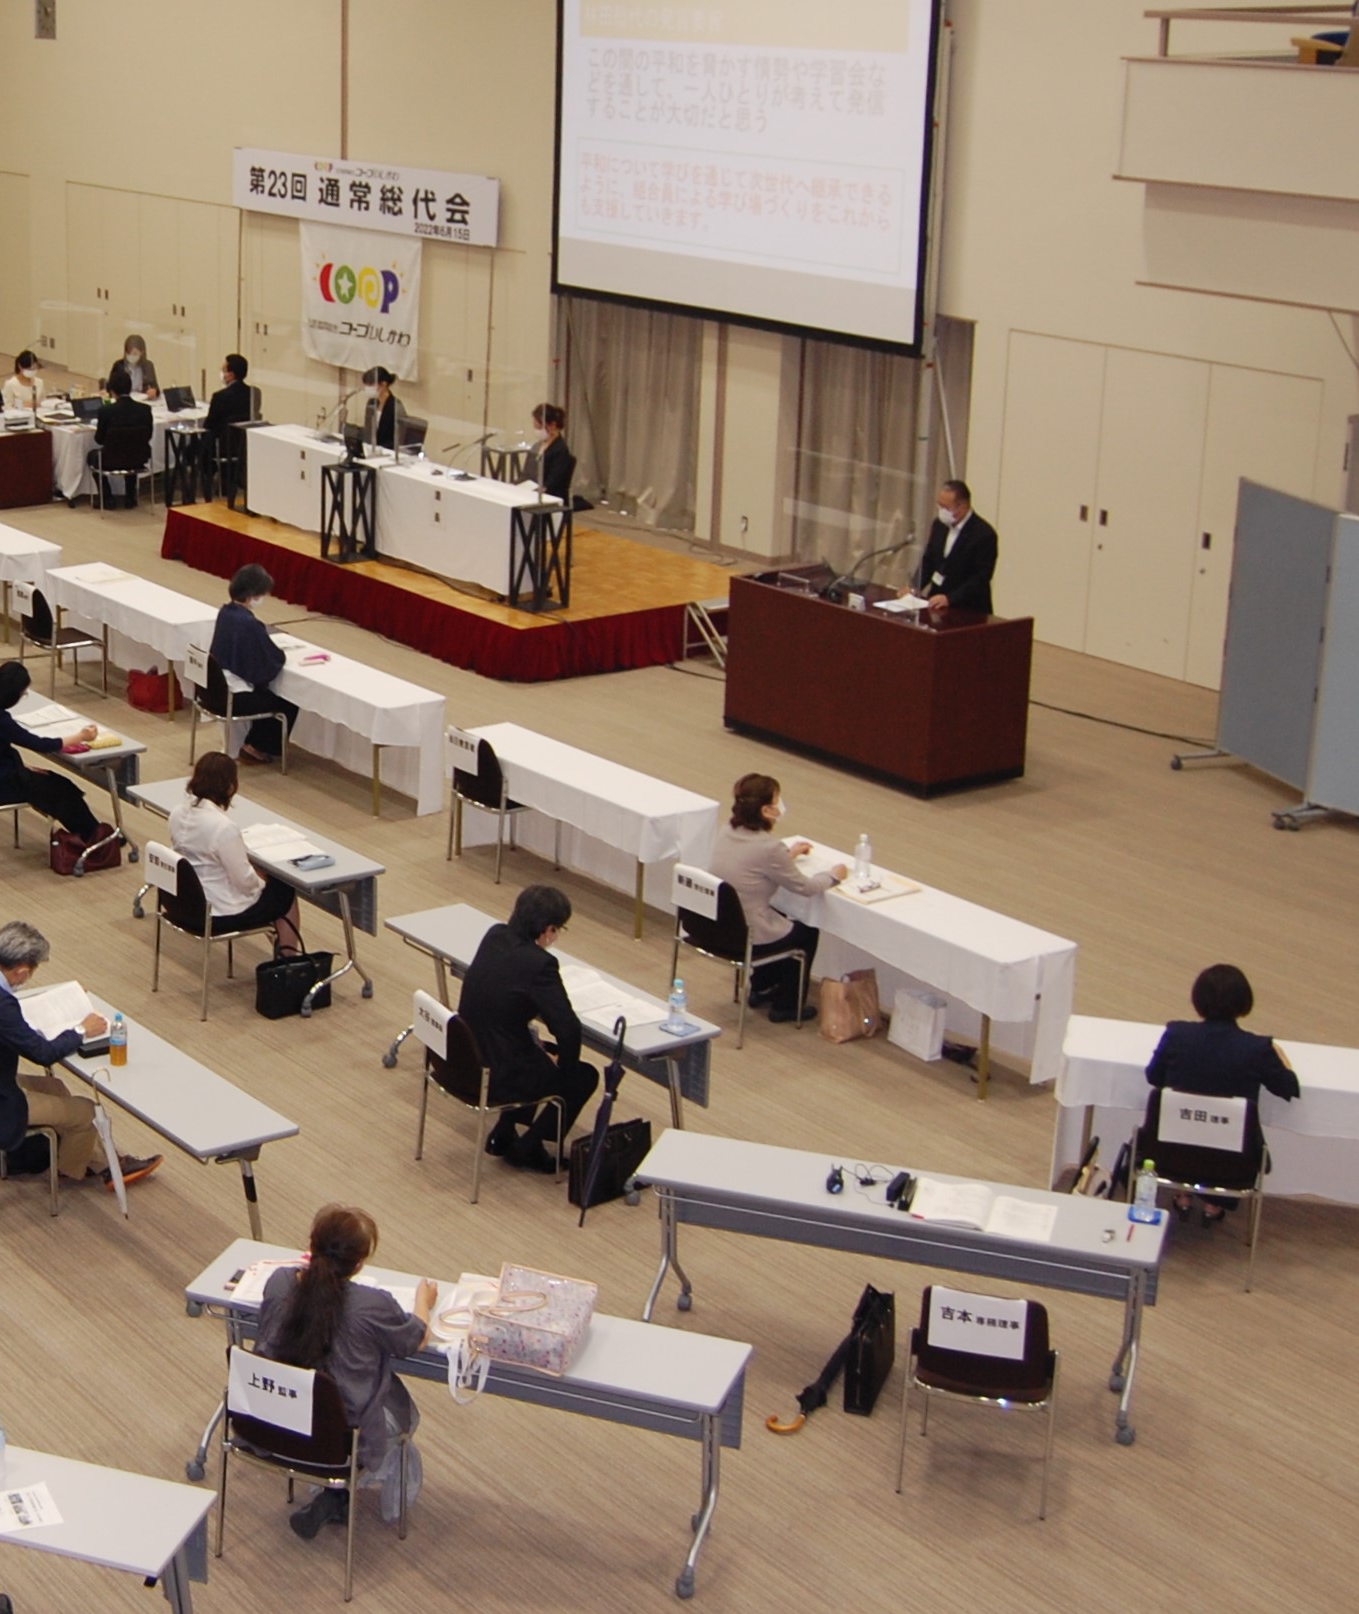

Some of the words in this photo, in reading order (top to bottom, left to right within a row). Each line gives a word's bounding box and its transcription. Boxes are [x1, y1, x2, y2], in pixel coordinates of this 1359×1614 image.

[586, 96, 768, 133] することが大切だと思う
[249, 166, 308, 202] 第23回
[318, 177, 471, 226] 通常総代会
[414, 222, 471, 241] 2022年6月15日
[319, 262, 400, 314] COOP
[1180, 1108, 1207, 1123] 吉田
[1210, 1115, 1229, 1125] 理事
[941, 1306, 972, 1323] 吉本
[976, 1316, 1020, 1330] 専務理事
[248, 1372, 275, 1393] 上野
[278, 1386, 297, 1399] 監事
